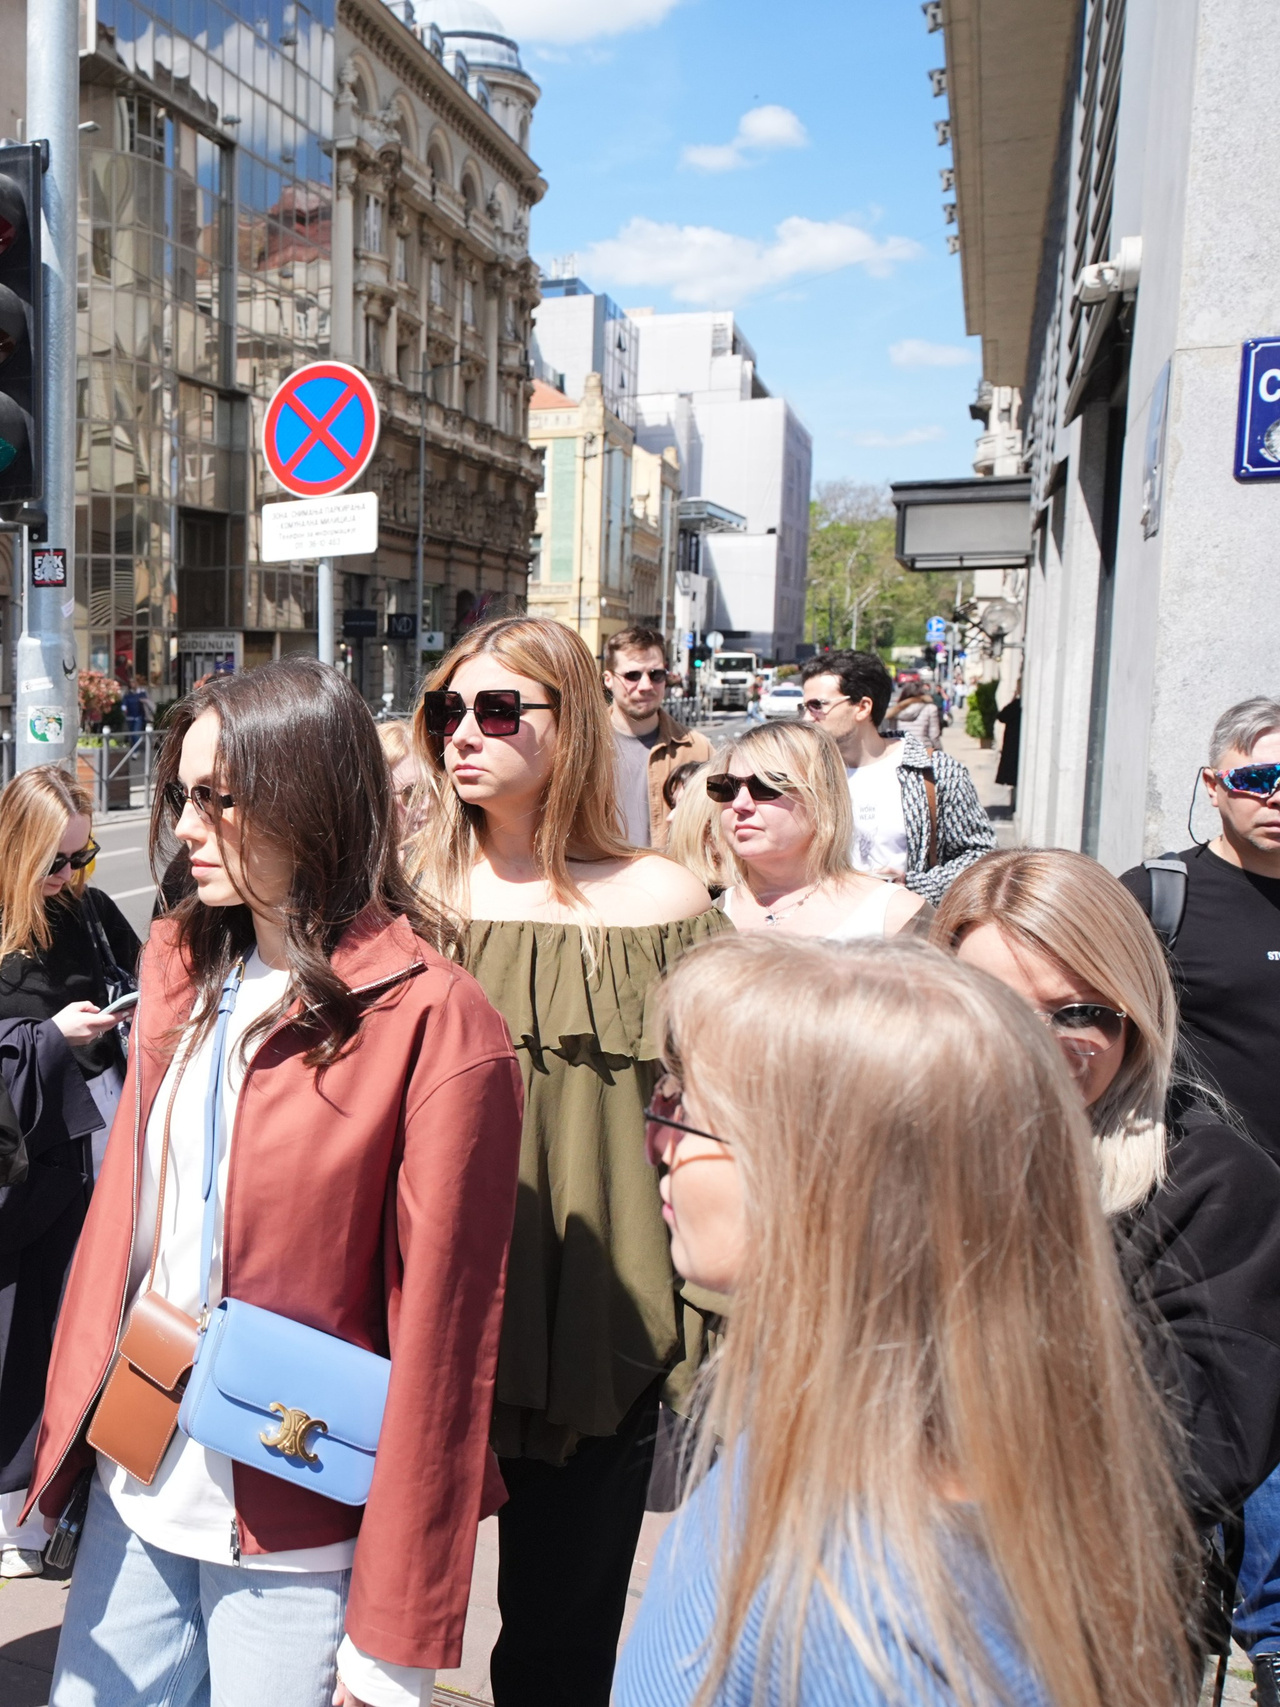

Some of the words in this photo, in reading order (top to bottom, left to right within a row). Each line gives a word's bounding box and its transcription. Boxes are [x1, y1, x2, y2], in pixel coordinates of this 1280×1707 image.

[34, 555, 64, 569] FK
[34, 568, 65, 581] SS
[1267, 950, 1280, 961] ST
